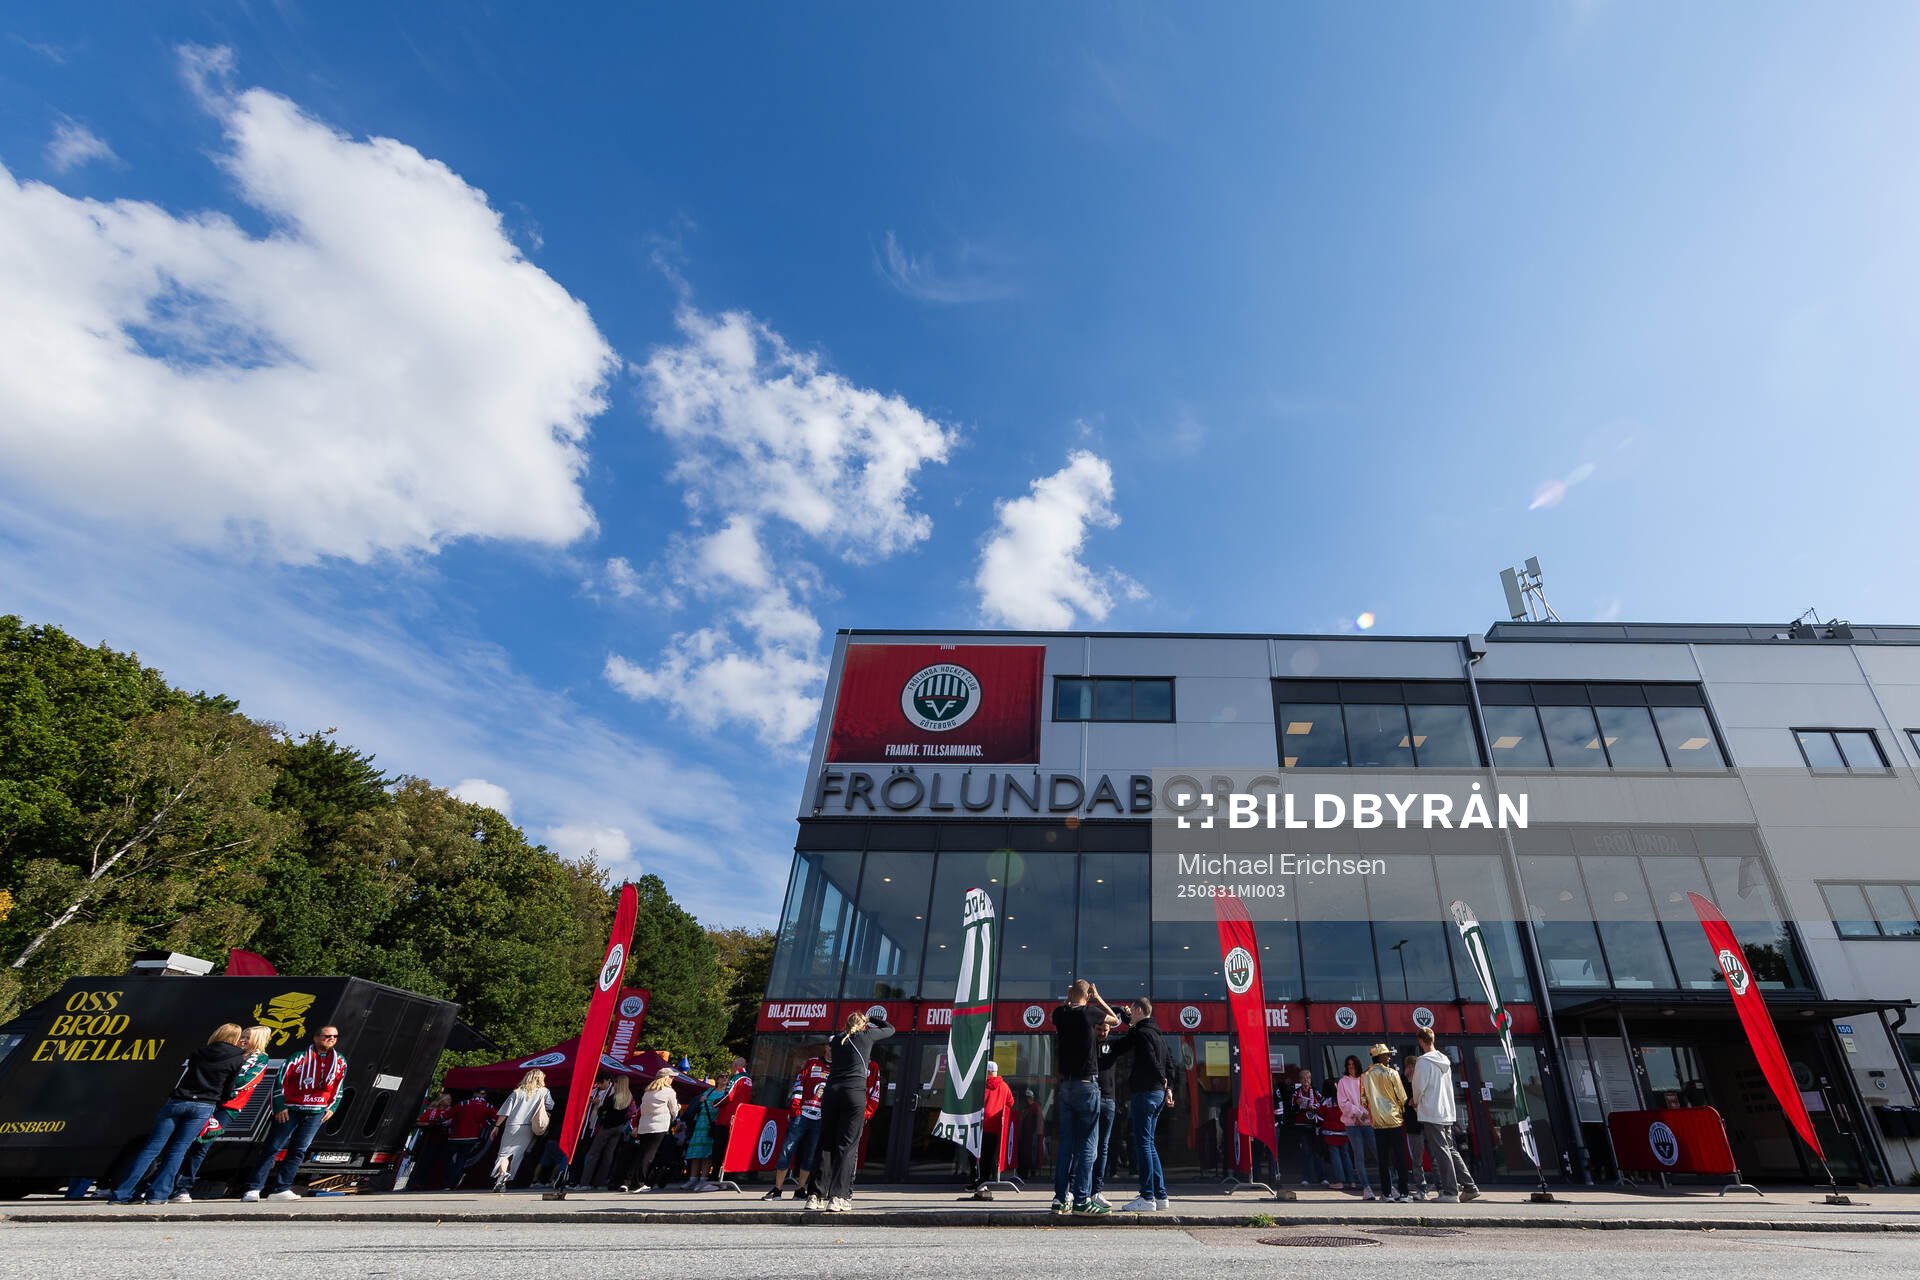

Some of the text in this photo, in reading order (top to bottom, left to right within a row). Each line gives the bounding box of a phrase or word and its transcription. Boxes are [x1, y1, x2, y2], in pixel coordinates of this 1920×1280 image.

[907, 666, 978, 691] FRÖLUNDA HOCKEY CLUB
[919, 719, 957, 730] GÖTEBORG
[922, 744, 984, 758] TILLSAMMANS.
[65, 991, 124, 1012] OSS
[767, 1004, 827, 1018] BILJETTKASSA
[926, 1008, 953, 1025] ENTR
[48, 1011, 130, 1036] BRÖD
[1838, 1025, 1852, 1033] 150
[32, 1039, 165, 1061] EMELLAN
